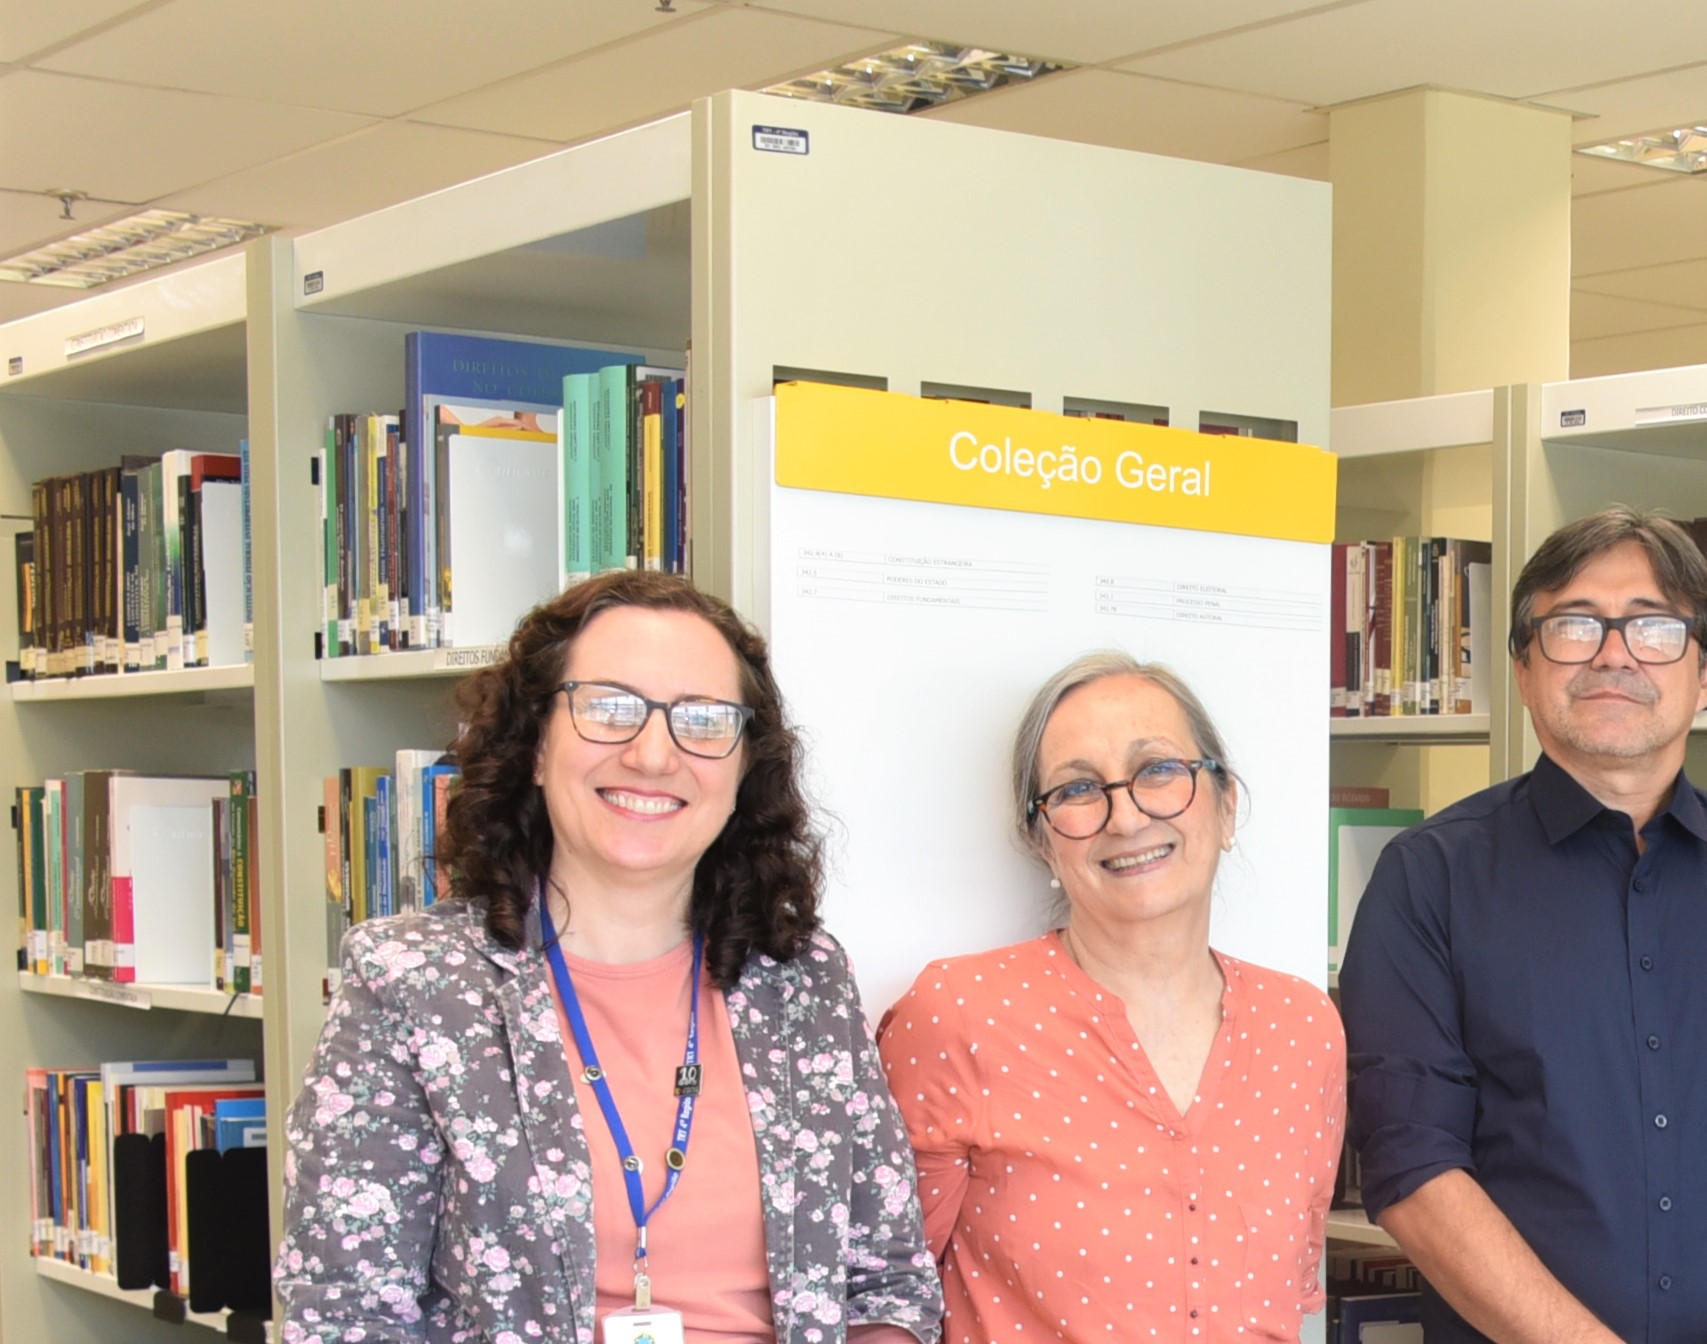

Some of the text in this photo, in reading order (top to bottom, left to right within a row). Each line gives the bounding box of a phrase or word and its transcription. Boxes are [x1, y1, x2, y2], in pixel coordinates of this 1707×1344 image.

[1671, 406, 1698, 417] DIREITO
[949, 432, 1210, 497] Coleção Geral
[446, 650, 480, 667] DIREITOS
[236, 858, 245, 928] CONSTITUIÇÃO
[679, 1066, 697, 1081] 10
[680, 1096, 693, 1119] Região
[676, 1129, 688, 1142] TRT
